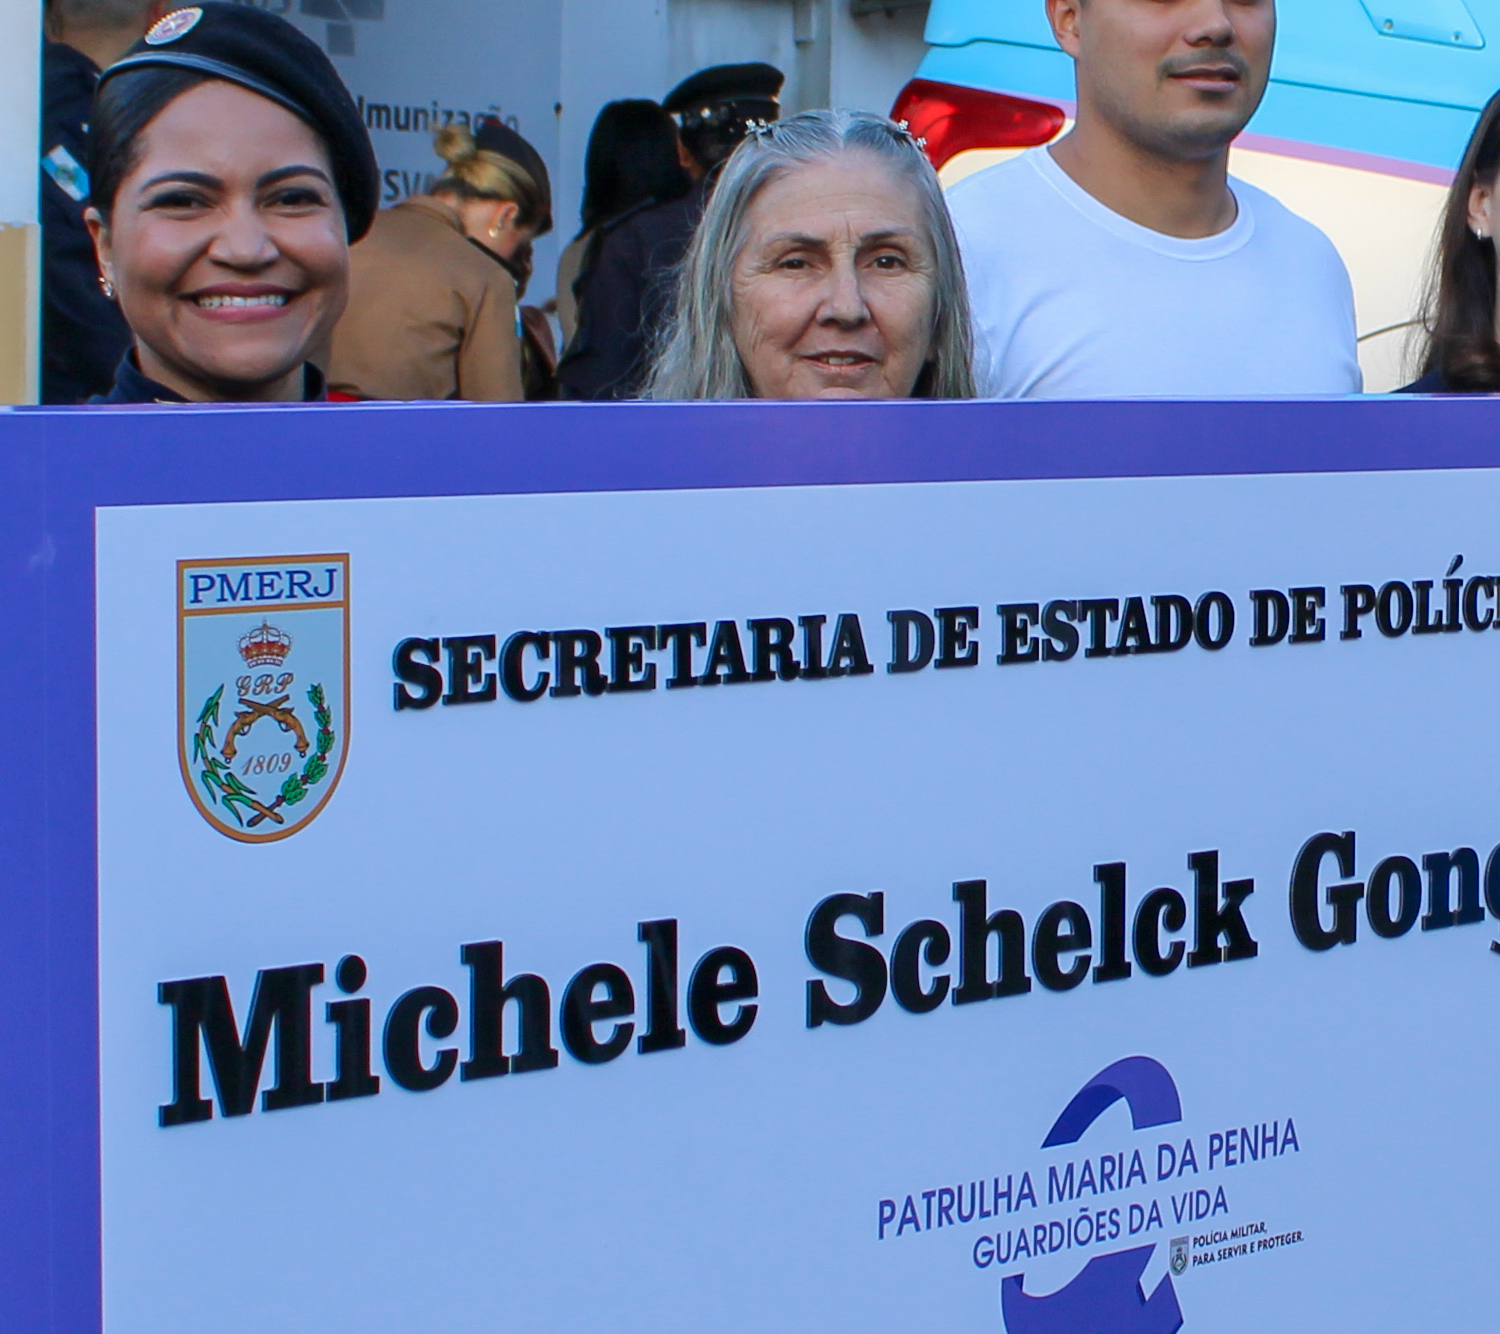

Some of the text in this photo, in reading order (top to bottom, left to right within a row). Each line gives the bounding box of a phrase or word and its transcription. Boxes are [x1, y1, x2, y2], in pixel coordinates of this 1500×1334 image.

[190, 568, 338, 604] PMERJ
[392, 613, 874, 712] SECRETARIA
[886, 605, 980, 674] DE
[995, 590, 1236, 667] ESTADO
[1249, 586, 1327, 647] DE
[241, 752, 292, 776] 1809
[156, 916, 760, 1128] Michele
[803, 849, 1258, 1030] Schelck
[878, 1117, 1300, 1240] PATRULHA MARIA DA PENHA
[973, 1185, 1229, 1269] GUARDIÕES DA VIDA
[1192, 1230, 1305, 1267] PARA SERVIR E PROTEGER.
[1193, 1221, 1267, 1249] POLÍCIA MILITAR,
